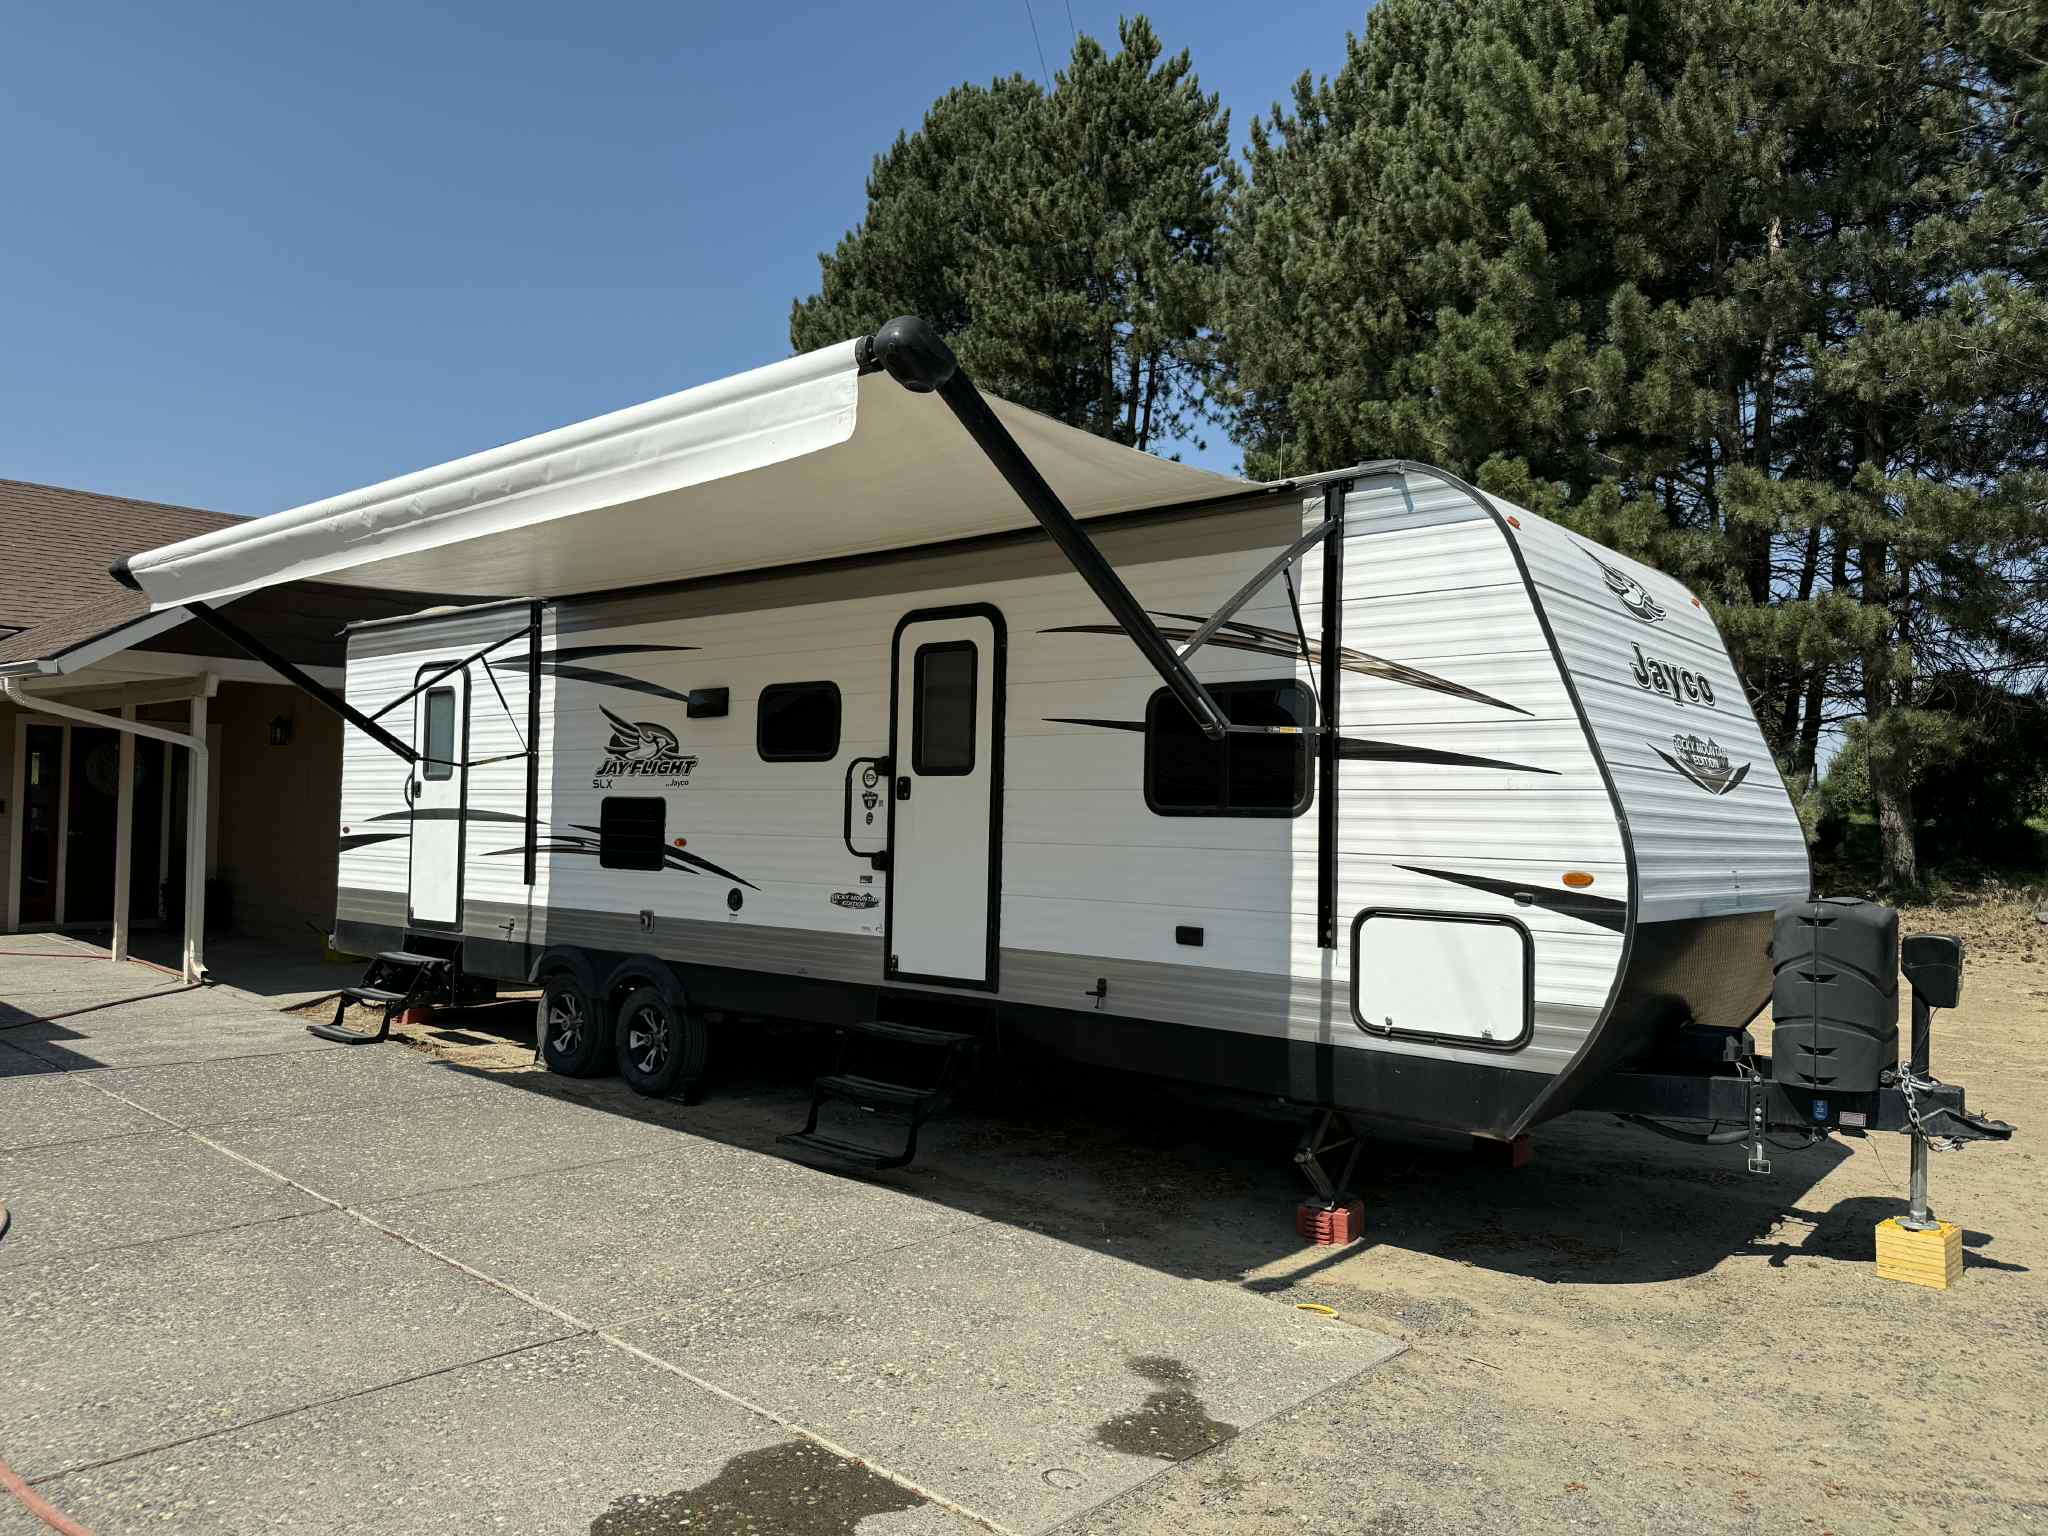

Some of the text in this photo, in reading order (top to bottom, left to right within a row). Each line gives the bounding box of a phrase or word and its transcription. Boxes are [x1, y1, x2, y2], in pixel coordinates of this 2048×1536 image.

[1629, 641, 1716, 707] Jayco
[597, 758, 697, 777] JAY FLIGHT
[592, 779, 613, 789] SLX
